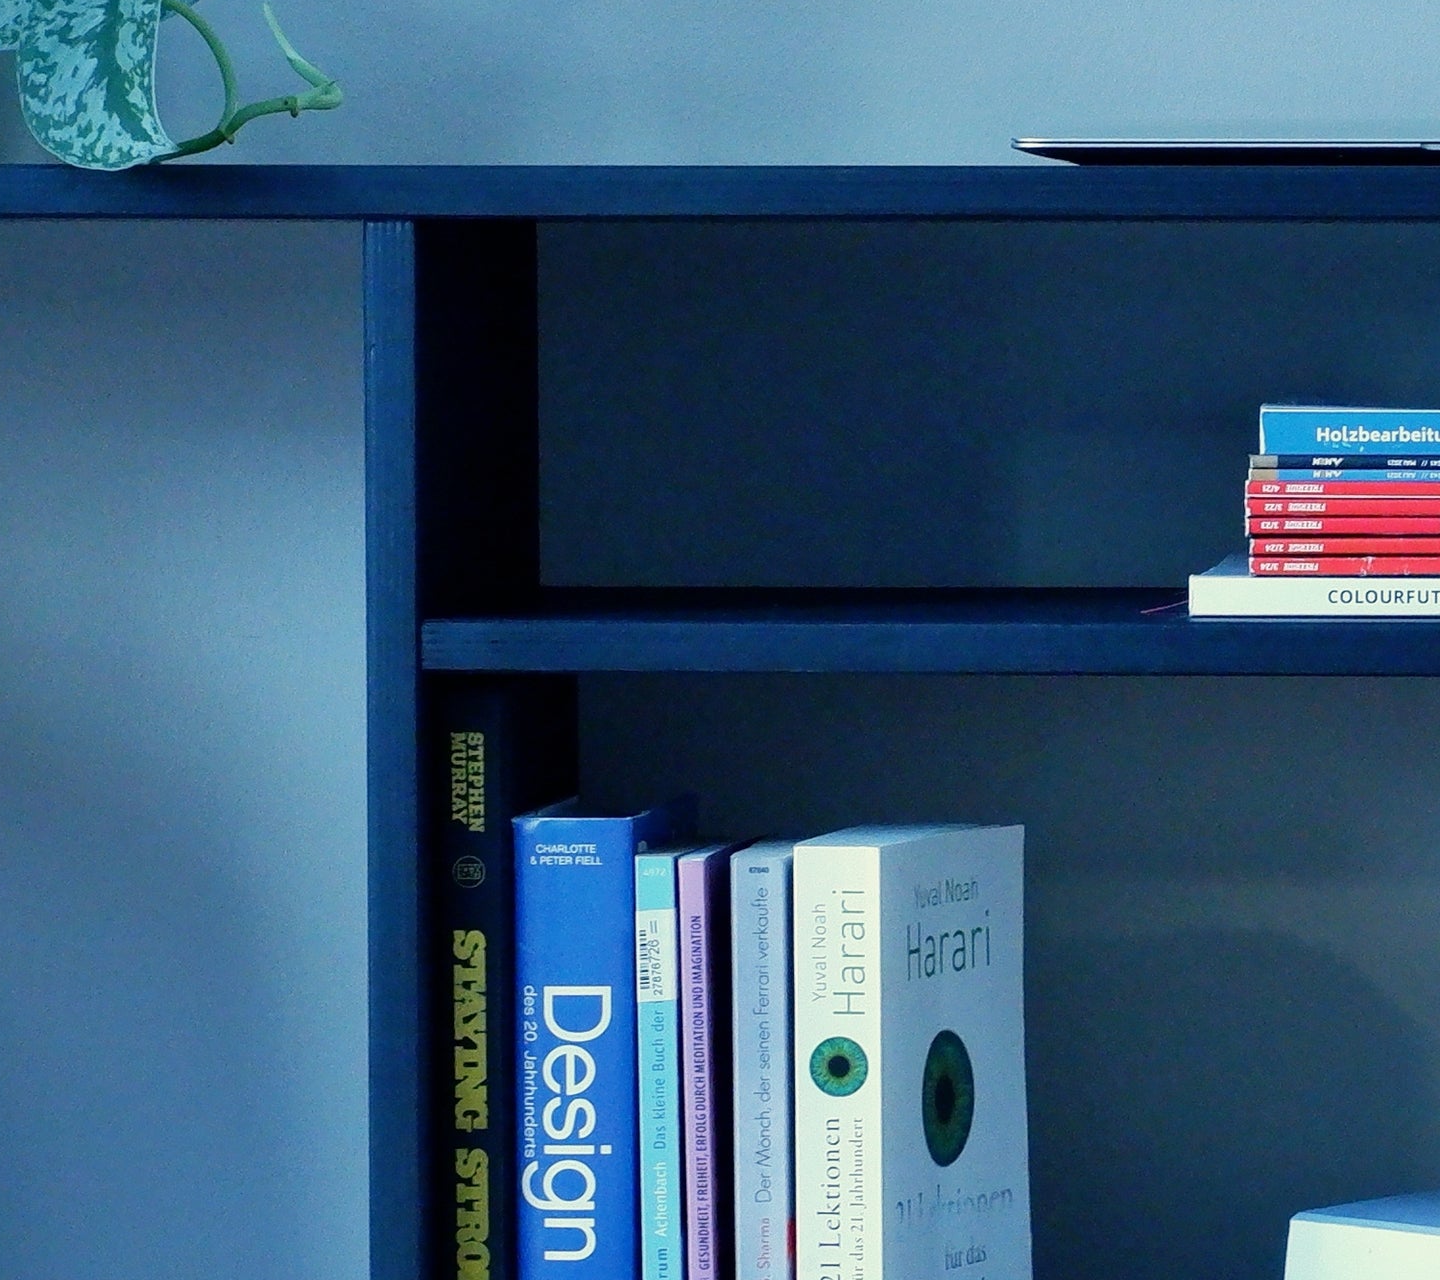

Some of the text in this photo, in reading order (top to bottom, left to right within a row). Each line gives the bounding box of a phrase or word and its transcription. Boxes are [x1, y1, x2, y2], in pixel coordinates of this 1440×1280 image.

[450, 732, 468, 824] MURRAY
[466, 732, 486, 832] STEPHEN
[529, 855, 603, 866] & PETER FIELL
[535, 843, 597, 854] CHARLOTTE
[945, 876, 979, 904] Noah
[750, 887, 770, 960] verkaufte
[906, 908, 991, 982] Harari
[690, 915, 703, 985] IMAGINATION
[810, 903, 827, 1002] Yuval Noah
[831, 889, 866, 1016] Harari
[691, 986, 704, 1009] UND
[752, 964, 770, 1016] Ferrari
[453, 929, 489, 1133] STAYING
[649, 1009, 665, 1033] der
[692, 1010, 706, 1074] MEDITATION
[757, 1020, 771, 1070] seinen
[522, 985, 539, 1159] des 20. Jahrhunderts
[650, 1037, 666, 1073] Buch
[650, 1077, 667, 1120] kleine
[693, 1076, 707, 1112] DURCH
[753, 1075, 772, 1103] der
[521, 985, 613, 1261] Design
[652, 1125, 667, 1151] Das
[694, 1113, 708, 1152] ERFOLG
[752, 1107, 772, 1168] Mönch,
[695, 1153, 711, 1202] FREIHEIT,
[753, 1173, 772, 1204] Der
[816, 1117, 842, 1249] Lektionen
[847, 1117, 867, 1210] Jahrhundert
[652, 1161, 670, 1238] Achenbach
[848, 1212, 864, 1233] 21.
[696, 1203, 712, 1272] GESUNDHEIT,
[755, 1217, 771, 1270] Sharma
[848, 1236, 864, 1262] das
